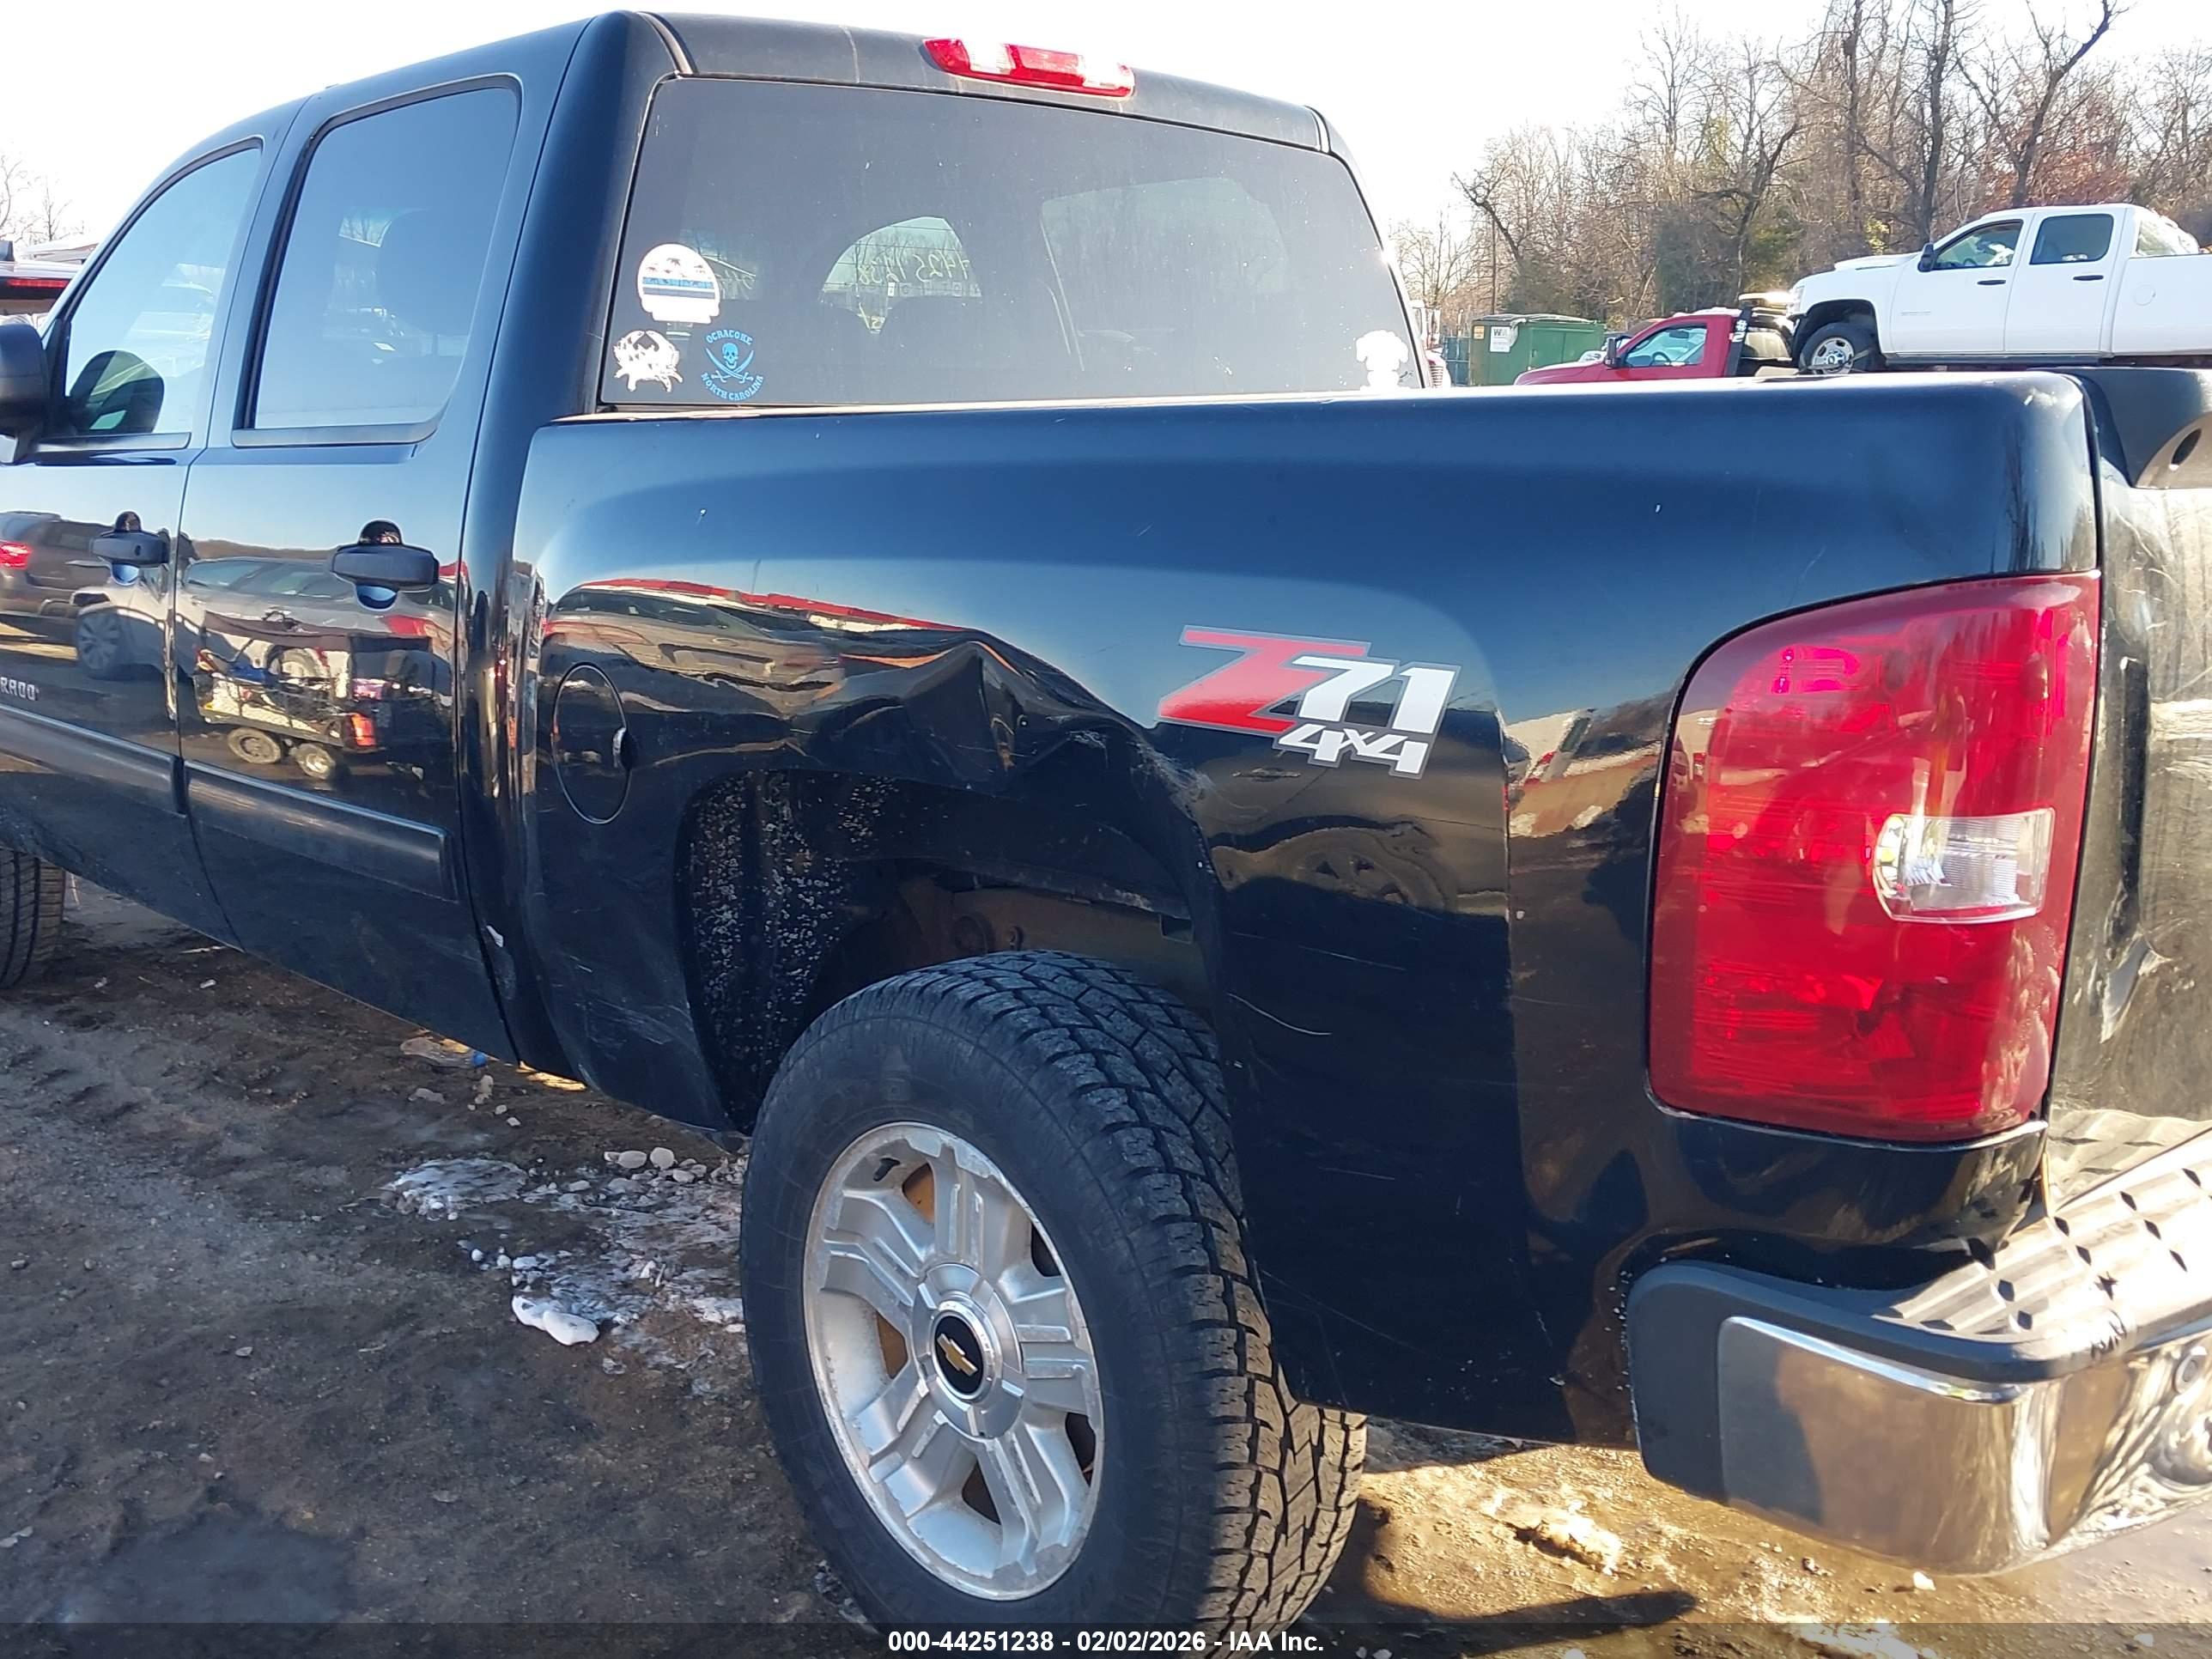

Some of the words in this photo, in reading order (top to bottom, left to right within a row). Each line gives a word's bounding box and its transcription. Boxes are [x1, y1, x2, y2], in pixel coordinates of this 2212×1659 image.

[706, 329, 754, 345] OCRACOKE
[701, 373, 727, 399] NORTH
[728, 374, 763, 401] CAROLINA
[1158, 625, 1460, 736] Z71
